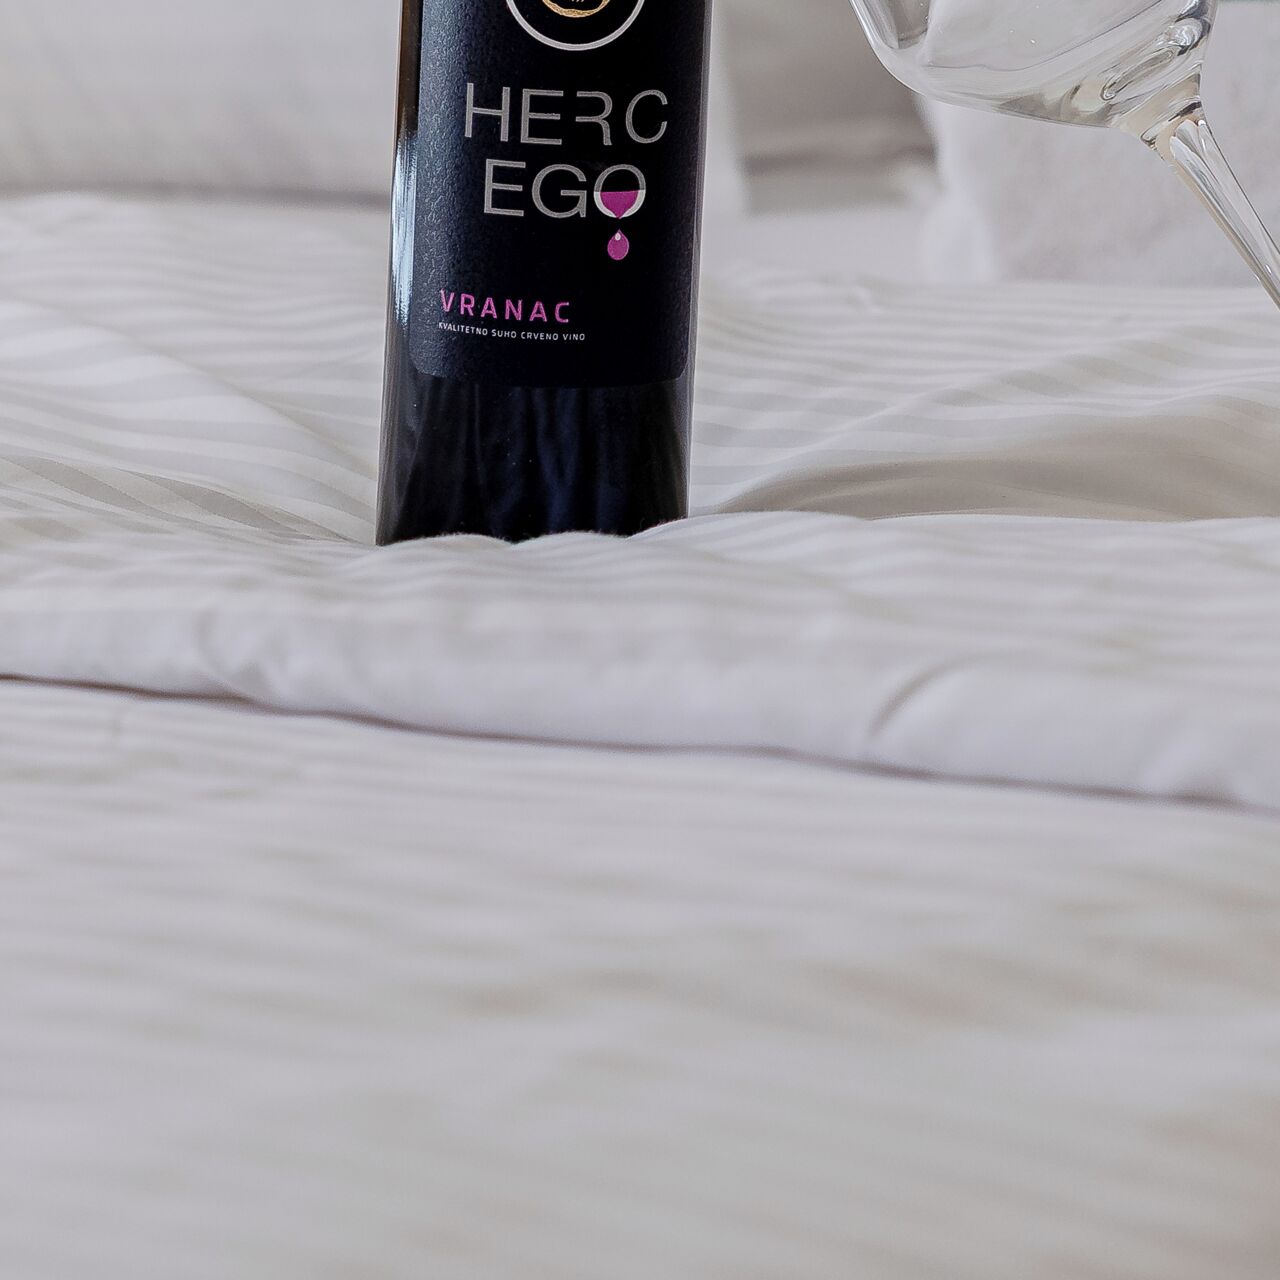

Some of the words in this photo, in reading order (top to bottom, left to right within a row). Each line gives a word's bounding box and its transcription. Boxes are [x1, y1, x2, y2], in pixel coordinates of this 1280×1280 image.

[464, 82, 669, 146] HERC
[483, 158, 647, 220] EGO
[440, 288, 570, 323] VRANAC
[438, 322, 488, 336] KVALITETNO
[491, 328, 517, 339] SUHO
[520, 331, 559, 341] CRVENO
[562, 333, 586, 341] VINO
